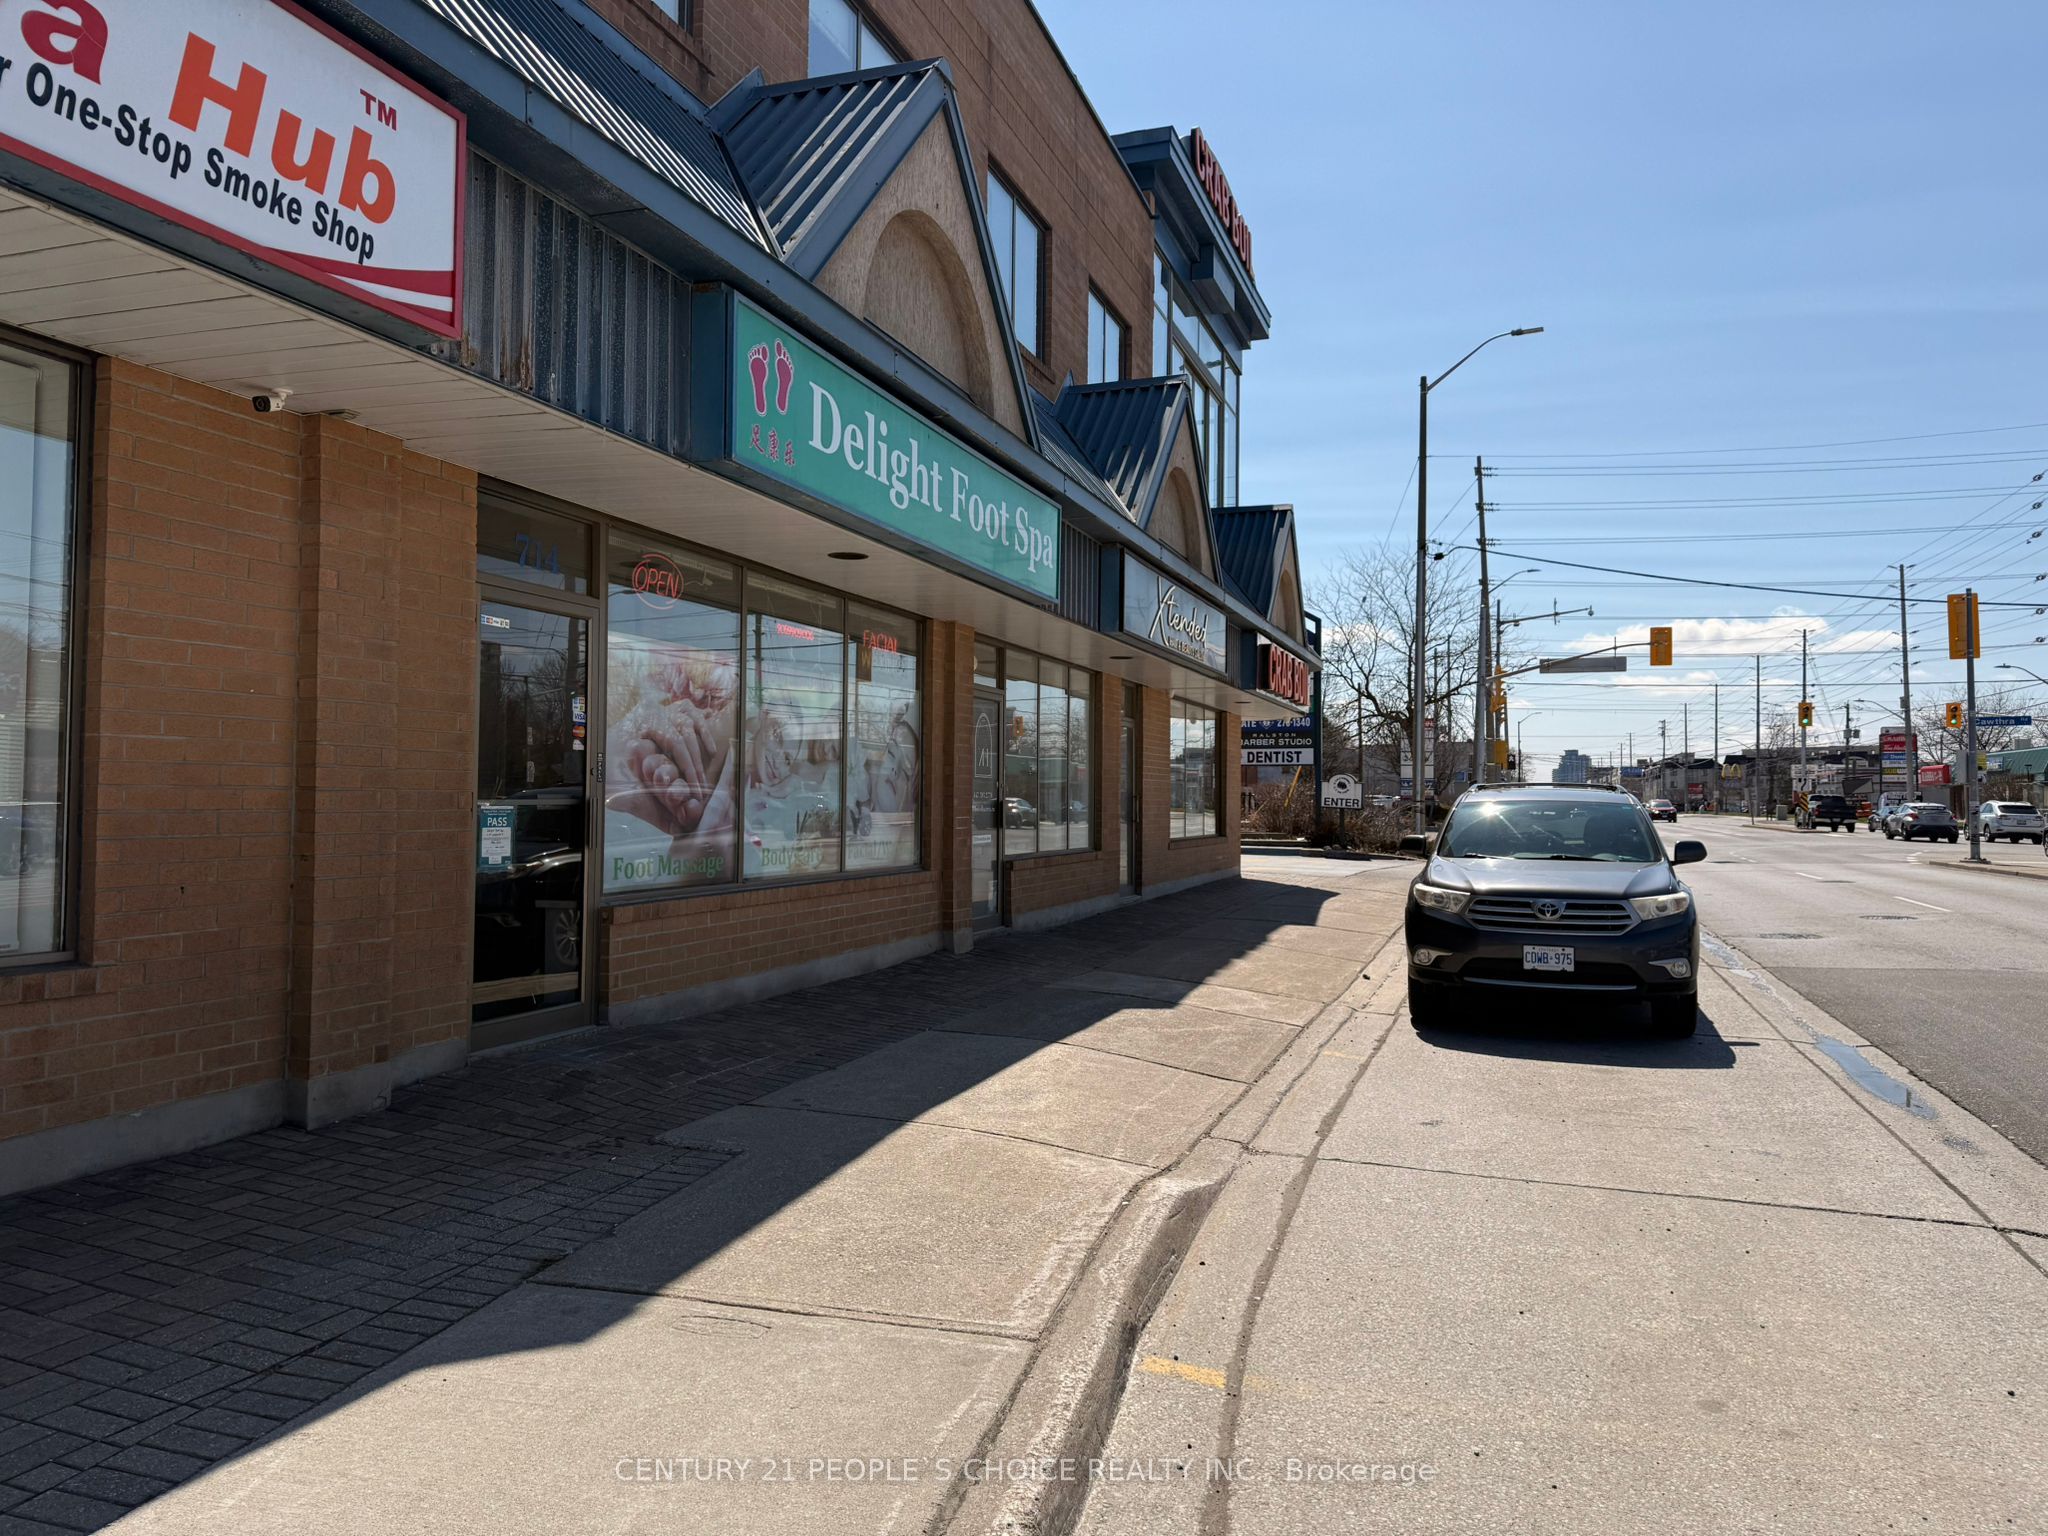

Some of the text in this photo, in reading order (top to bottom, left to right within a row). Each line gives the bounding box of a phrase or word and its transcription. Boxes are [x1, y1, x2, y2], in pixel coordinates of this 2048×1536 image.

[168, 31, 396, 225] Hub
[26, 63, 191, 179] One-Stop
[204, 148, 302, 225] Smoke
[312, 201, 374, 265] Shop
[808, 381, 1053, 573] Delight Foot Spa
[634, 565, 680, 599] OPEN
[1150, 576, 1208, 648] Xtended
[1268, 643, 1293, 697] CRAB
[1247, 751, 1302, 763] DENTIST
[1278, 738, 1312, 746] STUDIO
[1324, 797, 1360, 807] ENTER
[487, 817, 508, 826] PASS
[612, 852, 724, 881] Foot Massage
